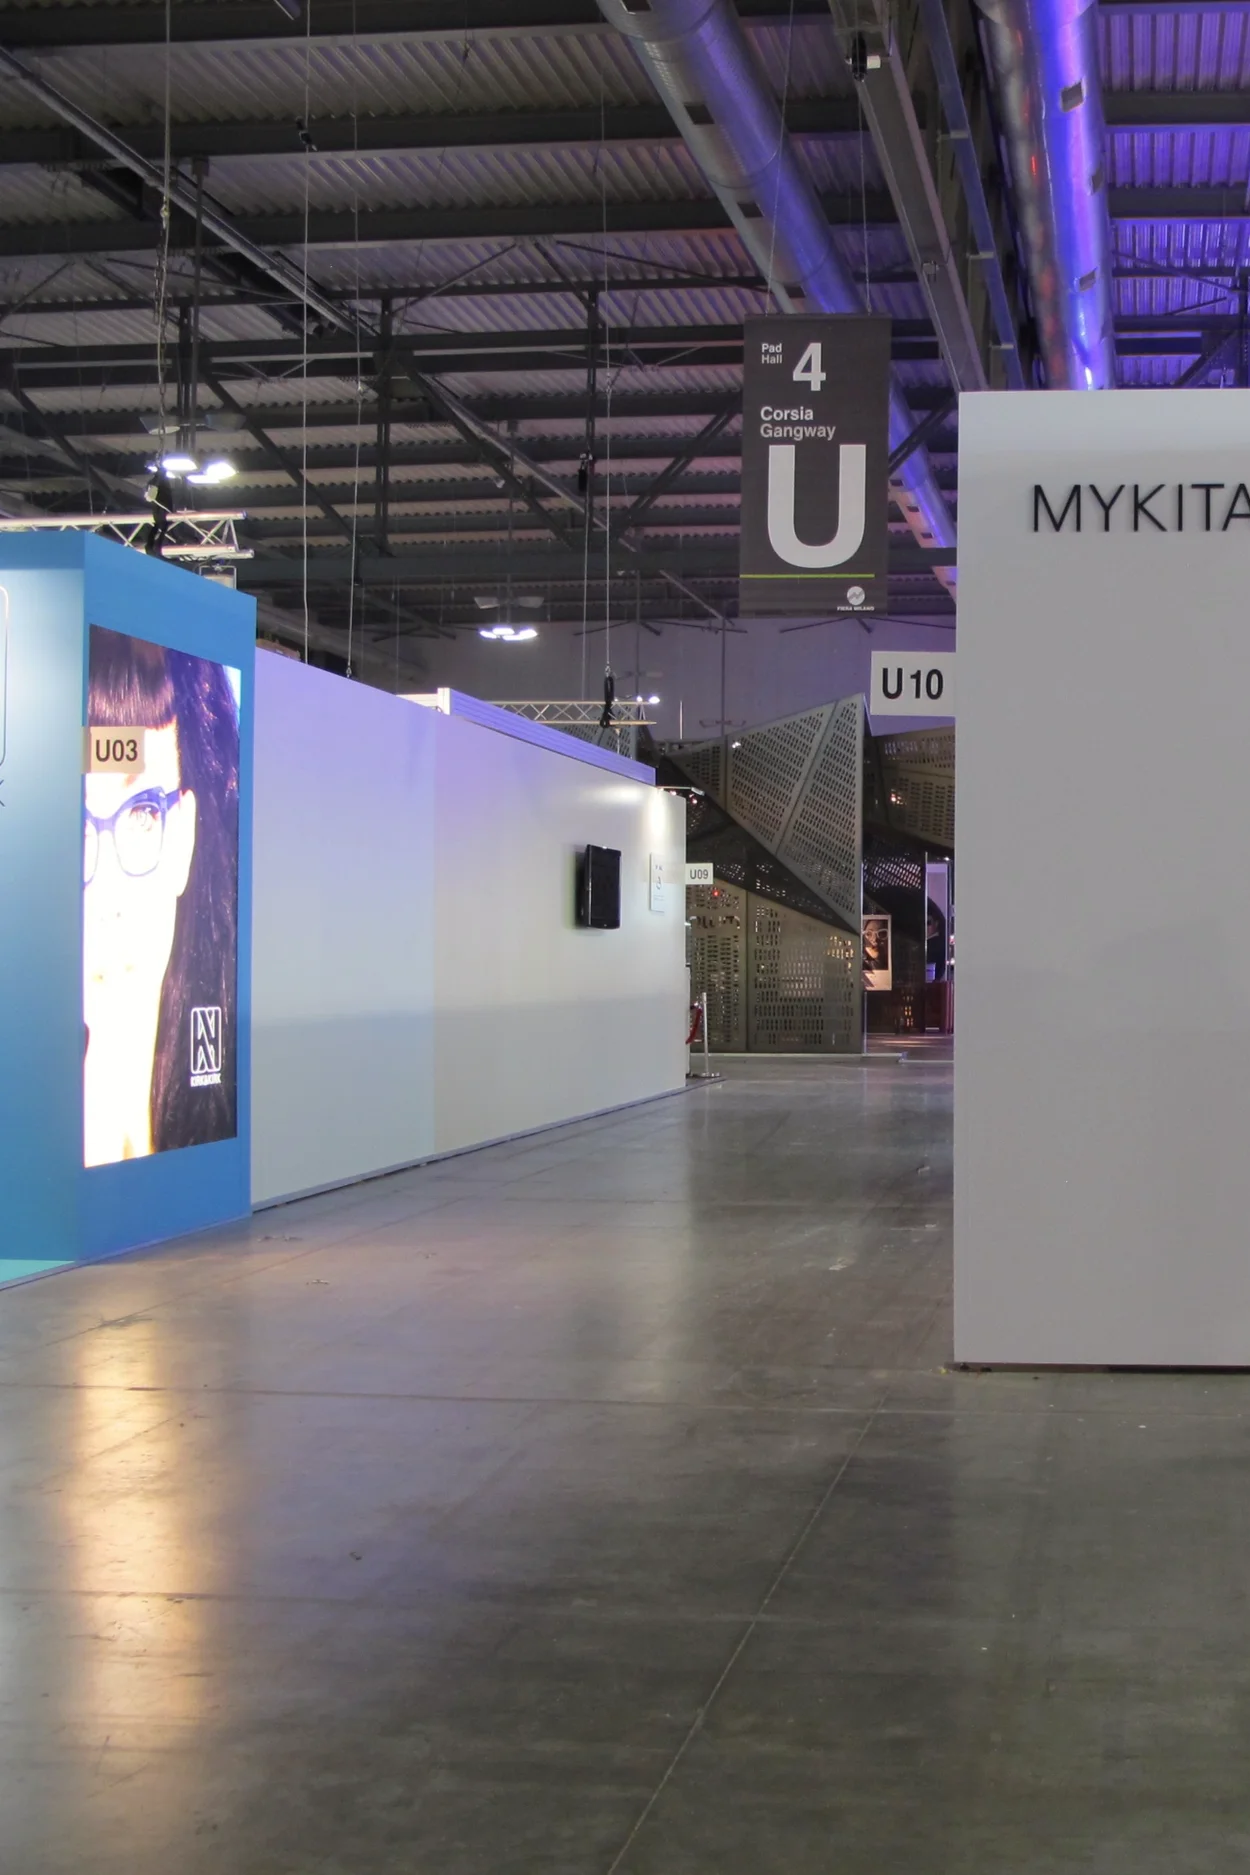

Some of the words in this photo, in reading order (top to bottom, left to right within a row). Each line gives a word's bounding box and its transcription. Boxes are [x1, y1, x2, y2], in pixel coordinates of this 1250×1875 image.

[761, 342, 783, 353] Pad
[761, 354, 783, 364] Hall
[792, 342, 827, 392] 4
[760, 406, 814, 421] Corsia
[760, 423, 836, 441] Gangway
[767, 444, 866, 569] U
[95, 738, 138, 763] U03
[689, 868, 709, 880] U09
